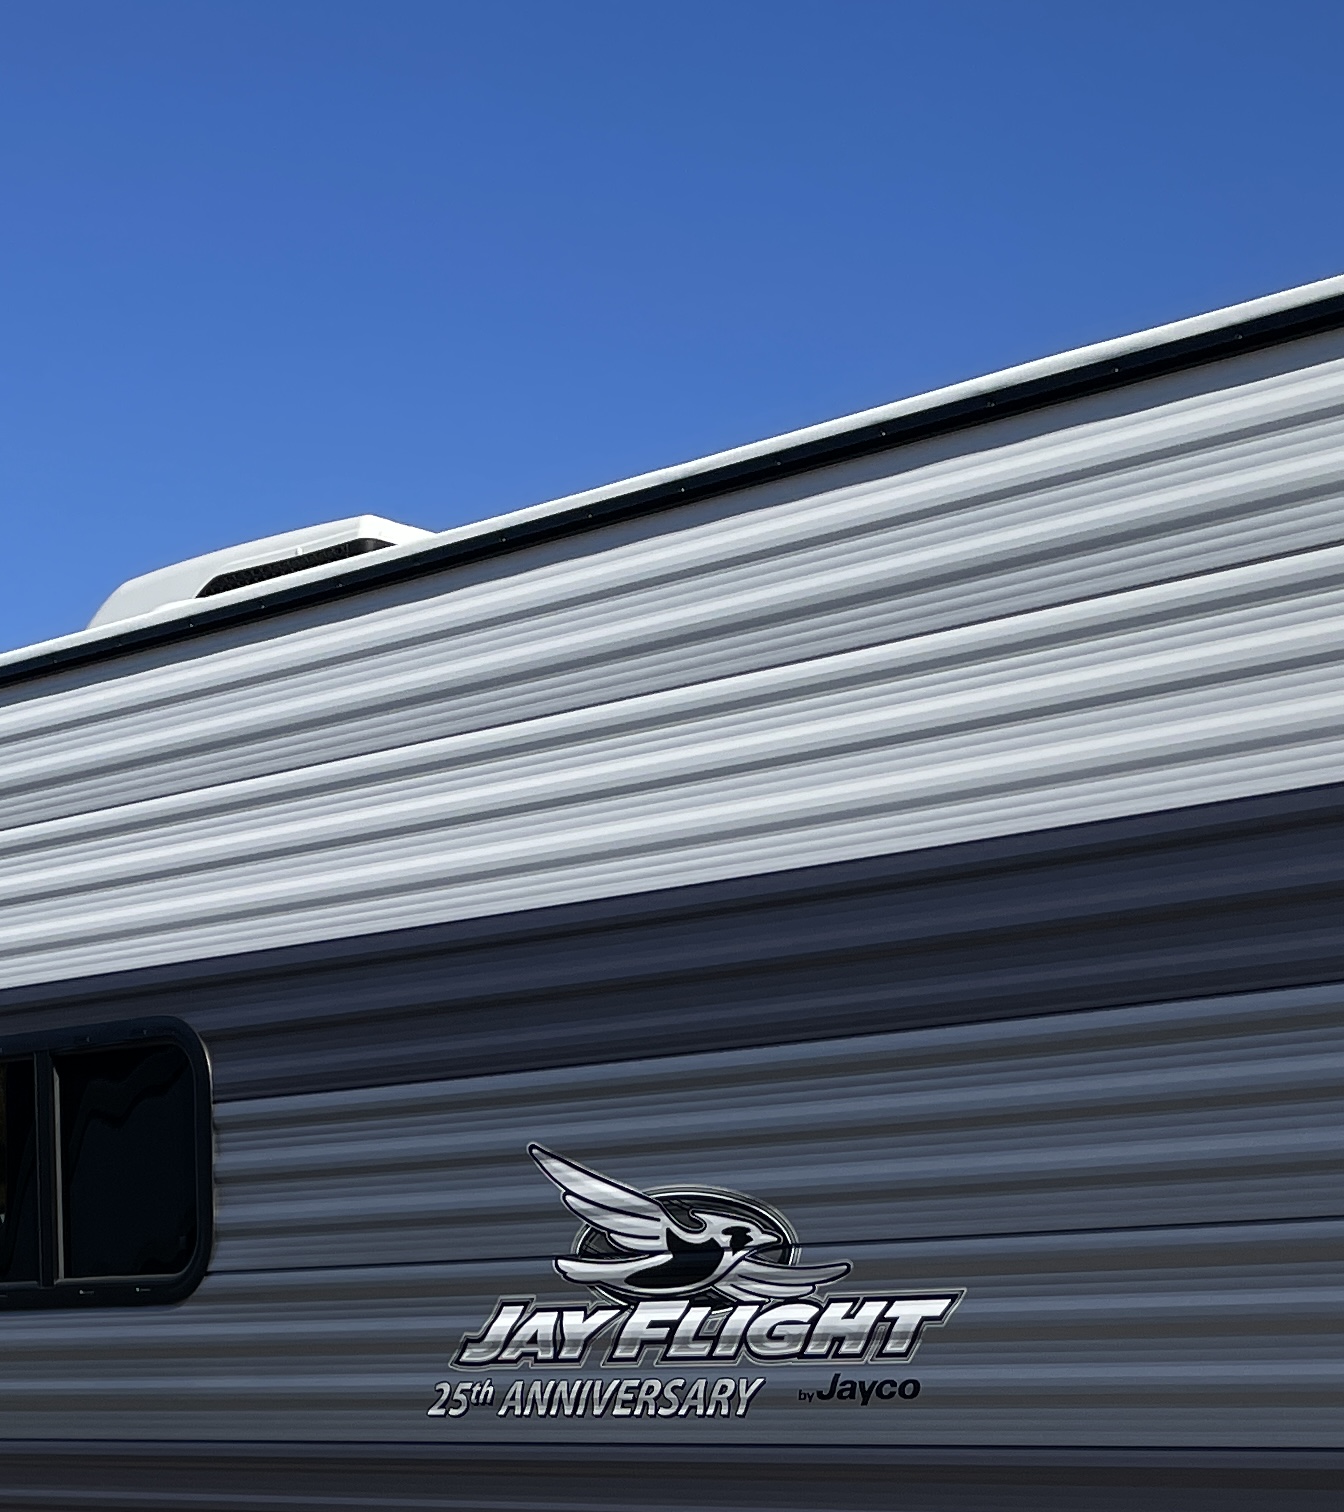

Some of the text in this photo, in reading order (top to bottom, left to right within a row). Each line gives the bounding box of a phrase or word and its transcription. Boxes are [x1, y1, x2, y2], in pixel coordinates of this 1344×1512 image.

[452, 1291, 963, 1367] JAY FLIGHT
[427, 1376, 767, 1418] 25th ANNIVERSARY
[798, 1373, 921, 1406] by Jayco
